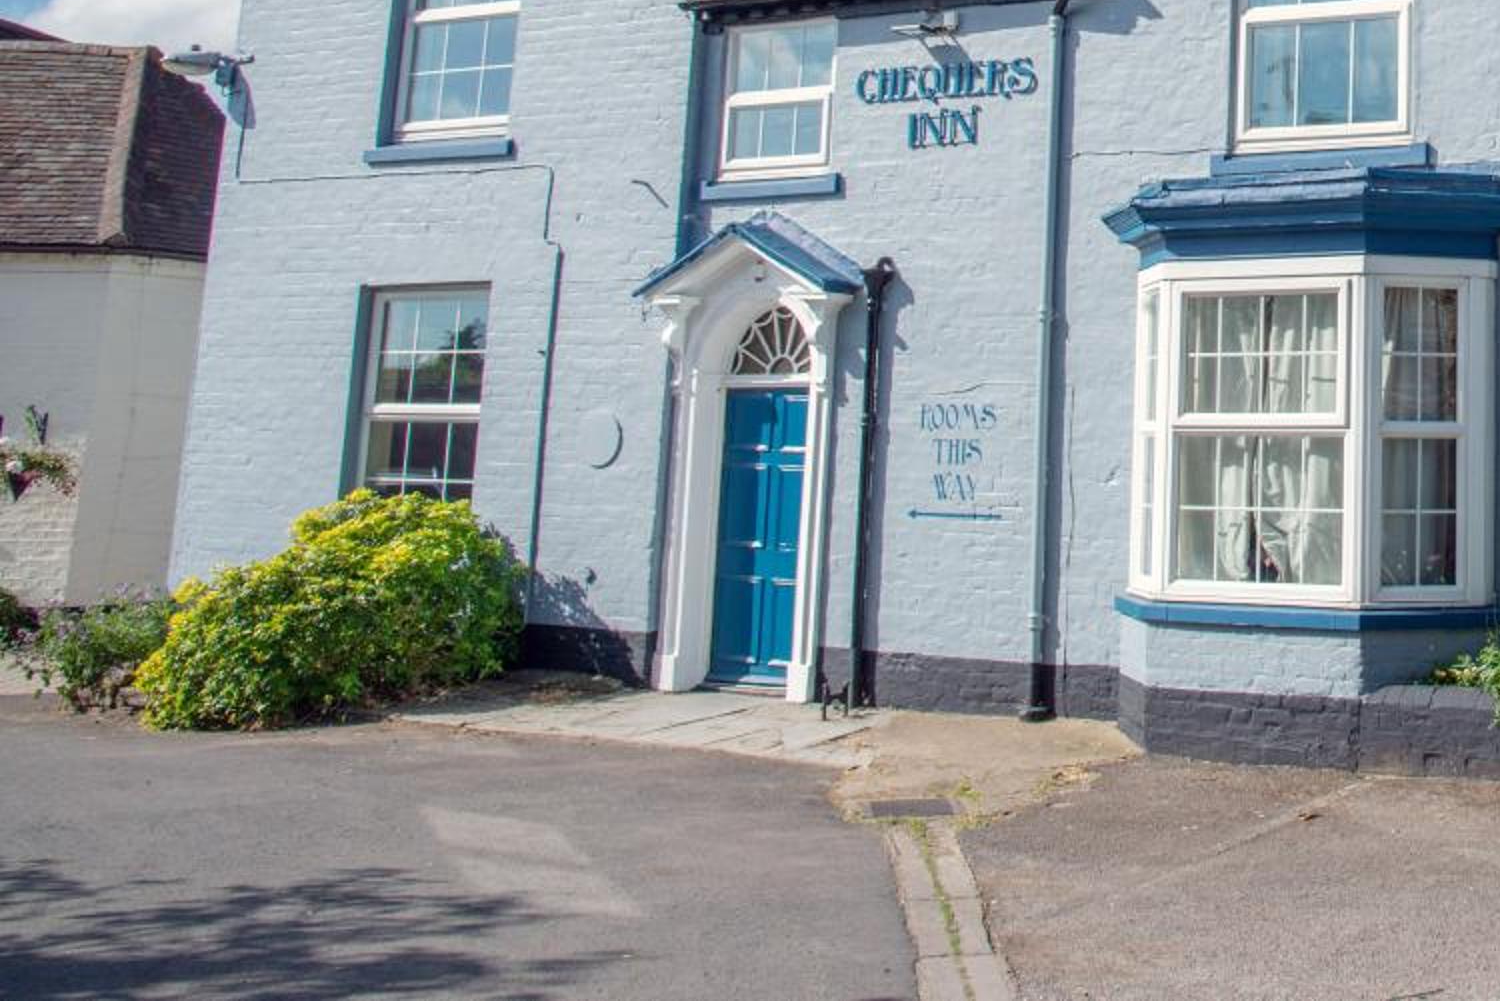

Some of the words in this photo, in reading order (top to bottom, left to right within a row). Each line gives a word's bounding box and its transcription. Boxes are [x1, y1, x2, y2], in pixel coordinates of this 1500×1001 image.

[856, 57, 1038, 104] CHEQUERS
[908, 105, 982, 149] INN
[920, 403, 997, 432] ROOMS
[931, 437, 982, 465] THIS
[932, 473, 977, 501] WAY
